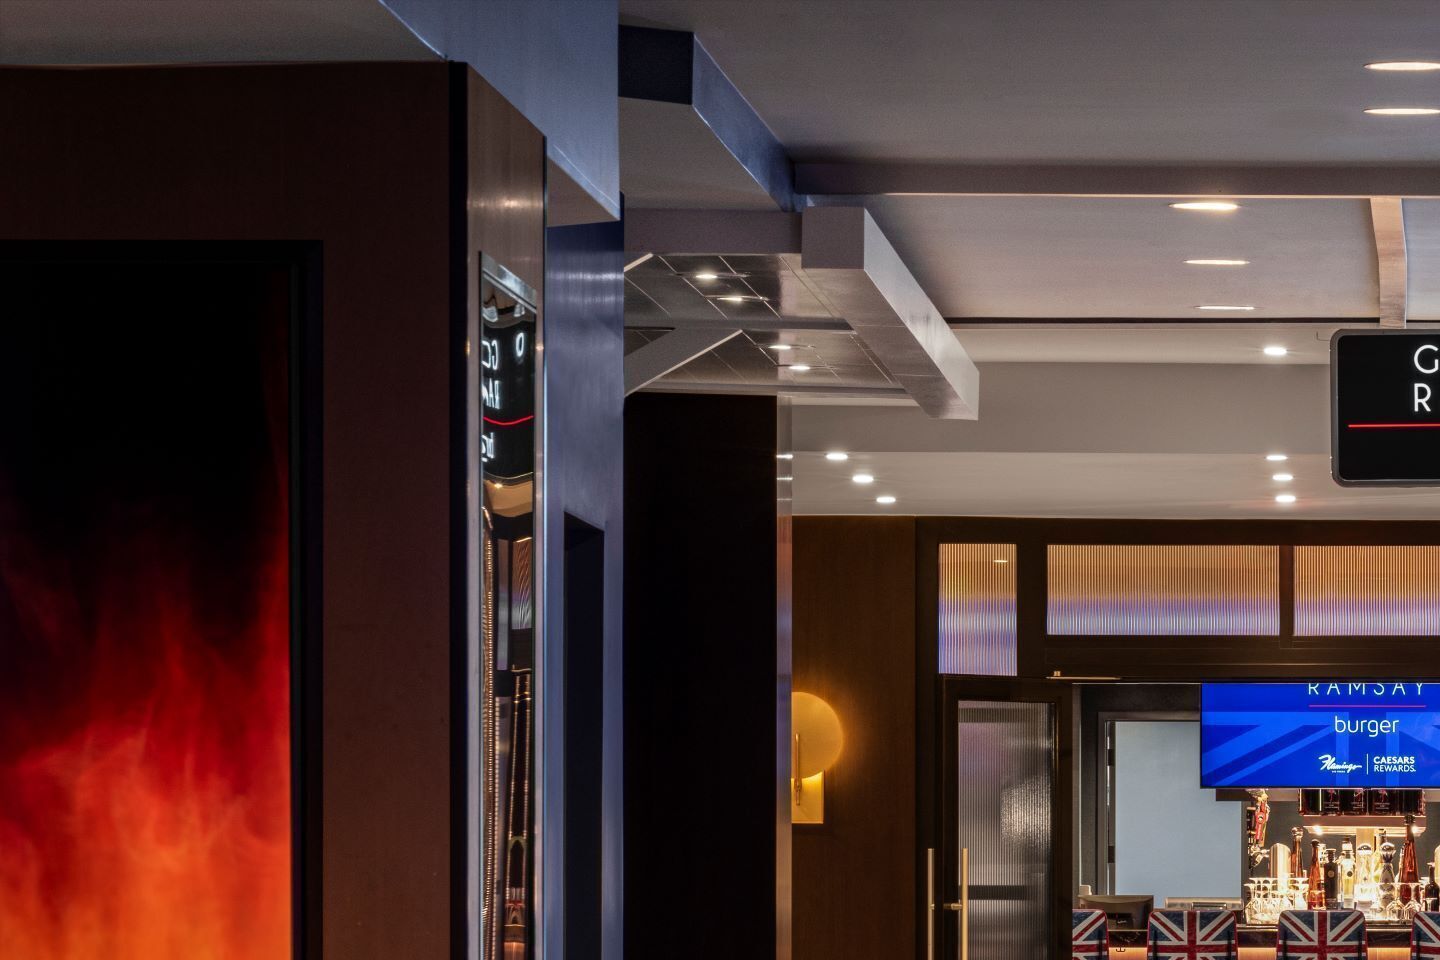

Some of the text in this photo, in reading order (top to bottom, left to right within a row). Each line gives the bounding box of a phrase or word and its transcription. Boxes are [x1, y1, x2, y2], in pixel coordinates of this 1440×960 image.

[1334, 715, 1400, 738] burger
[1318, 754, 1363, 774] Flamingo
[1373, 756, 1415, 764] CAESARS
